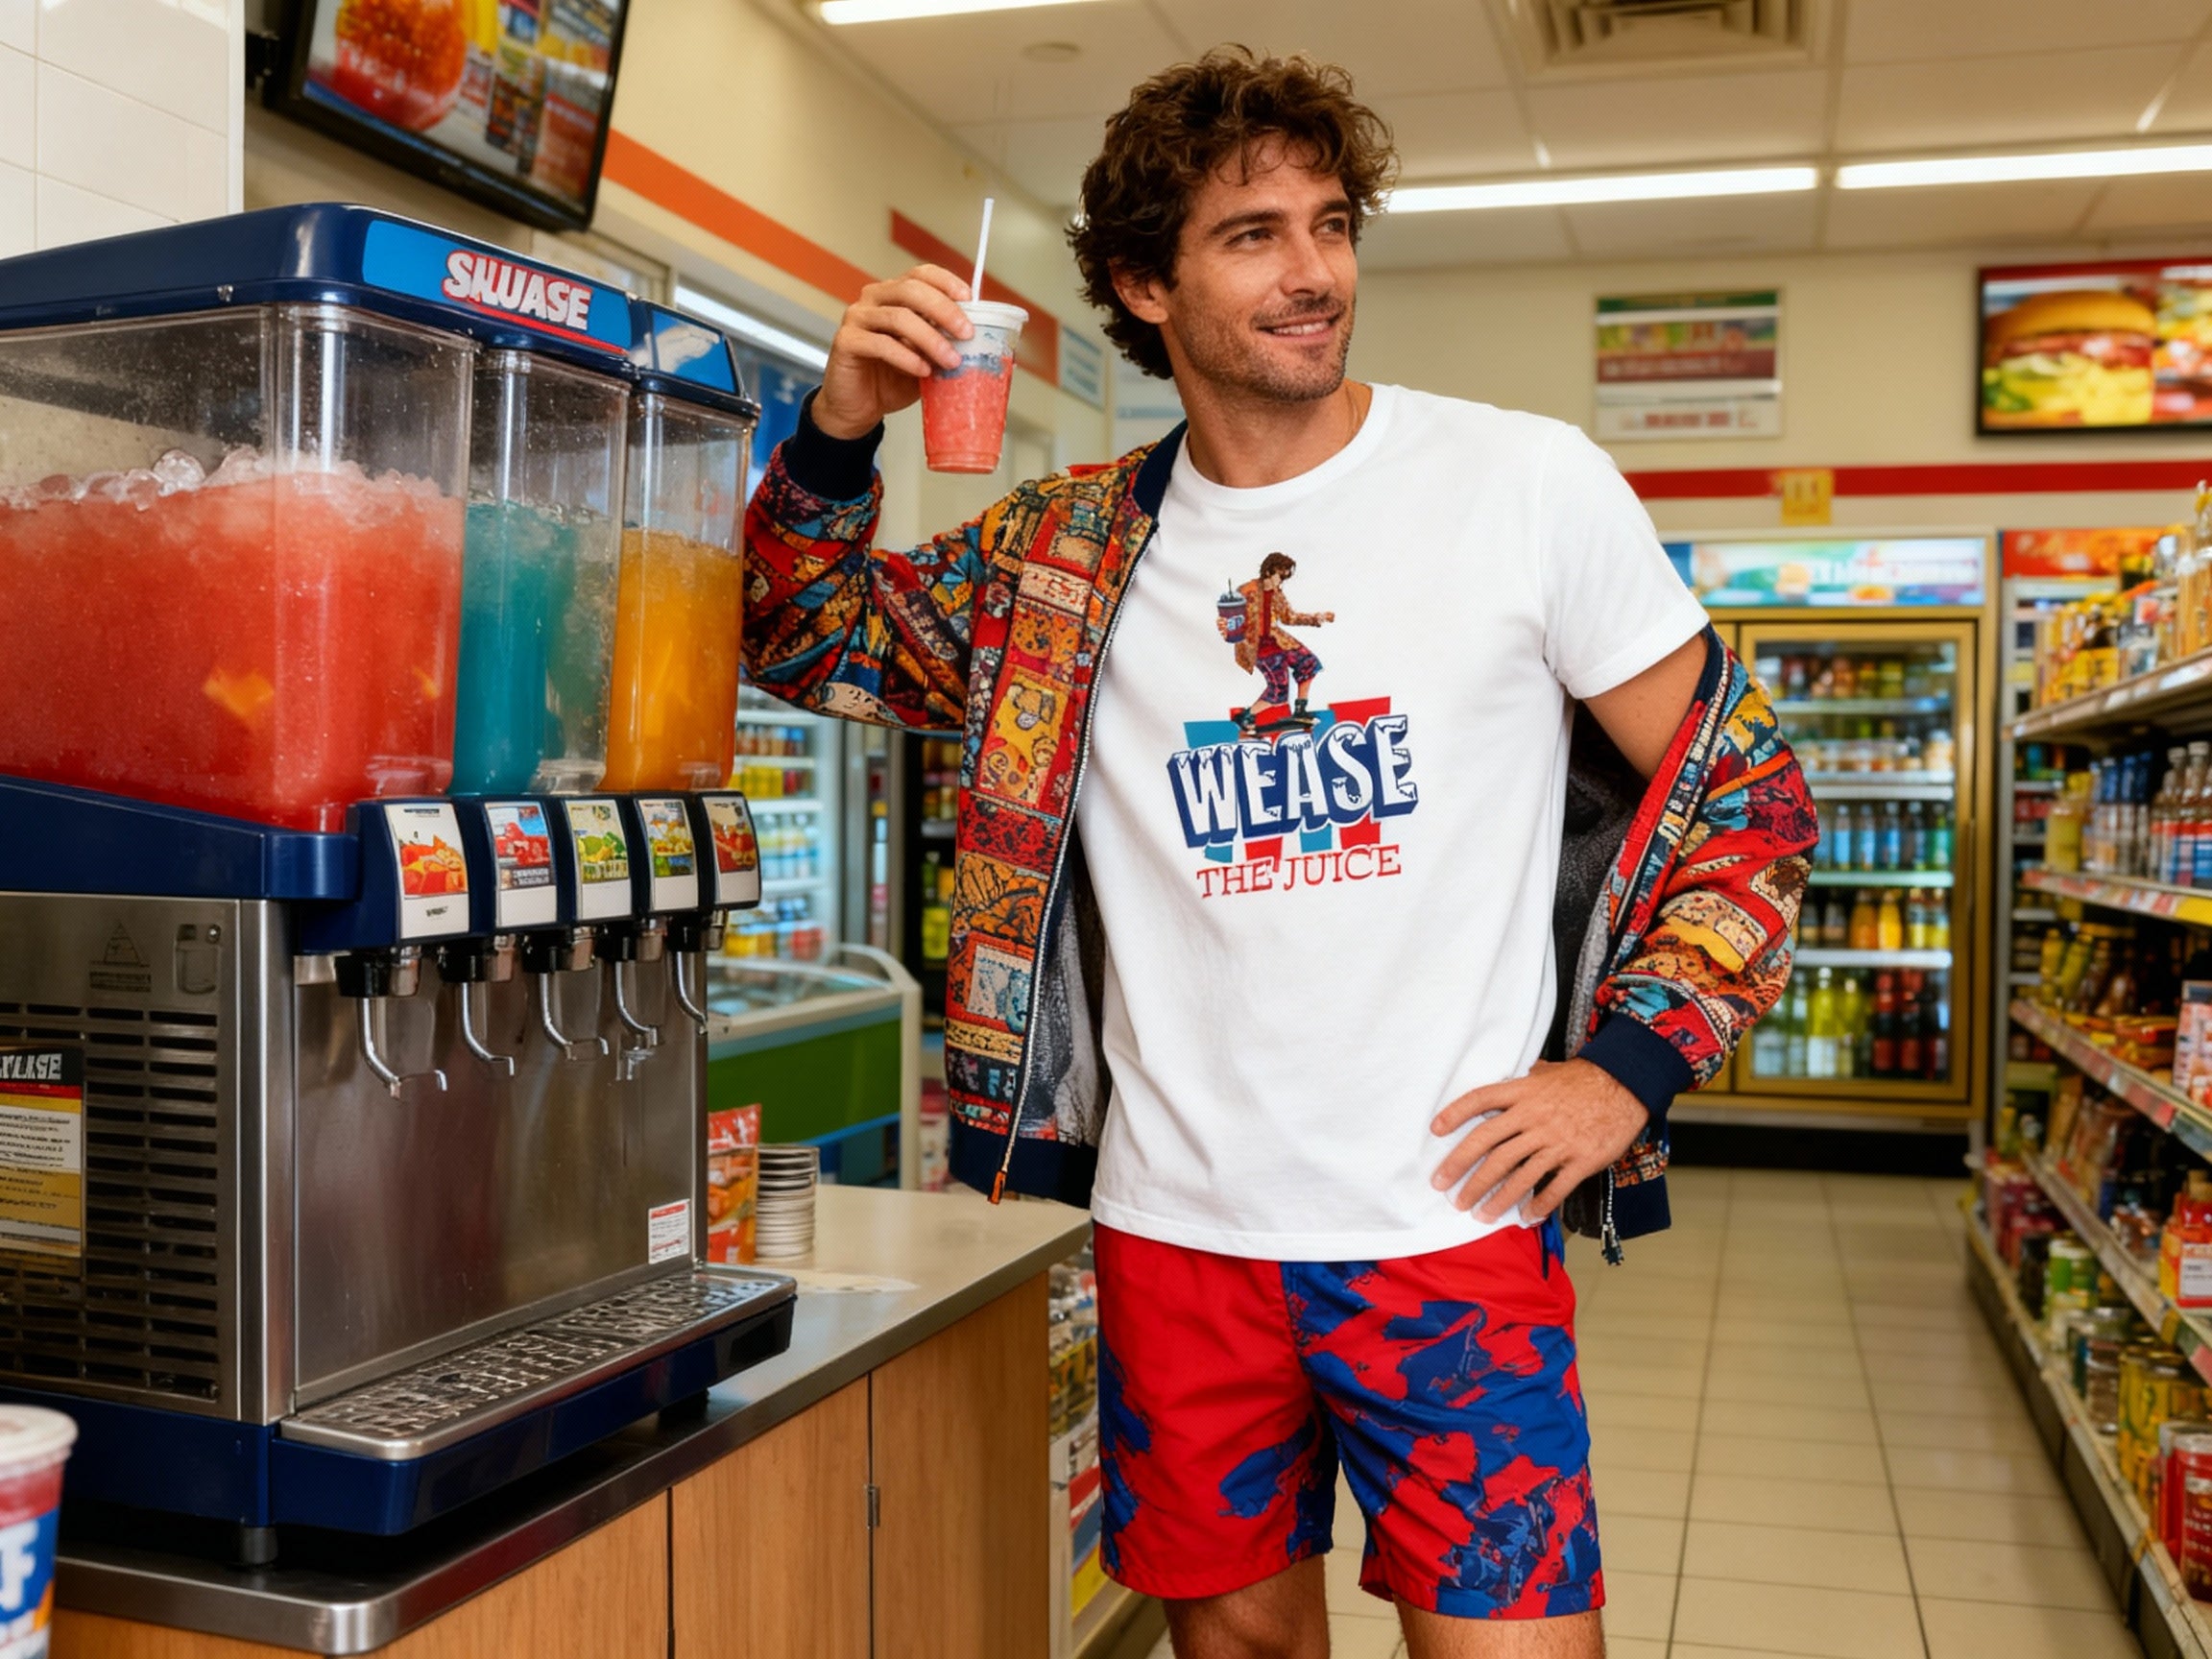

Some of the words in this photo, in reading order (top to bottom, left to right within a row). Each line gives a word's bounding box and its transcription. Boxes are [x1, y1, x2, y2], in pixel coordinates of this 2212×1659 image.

[1166, 714, 1418, 849] WEASE
[1196, 856, 1274, 899] THE
[1283, 845, 1402, 891] JUICE
